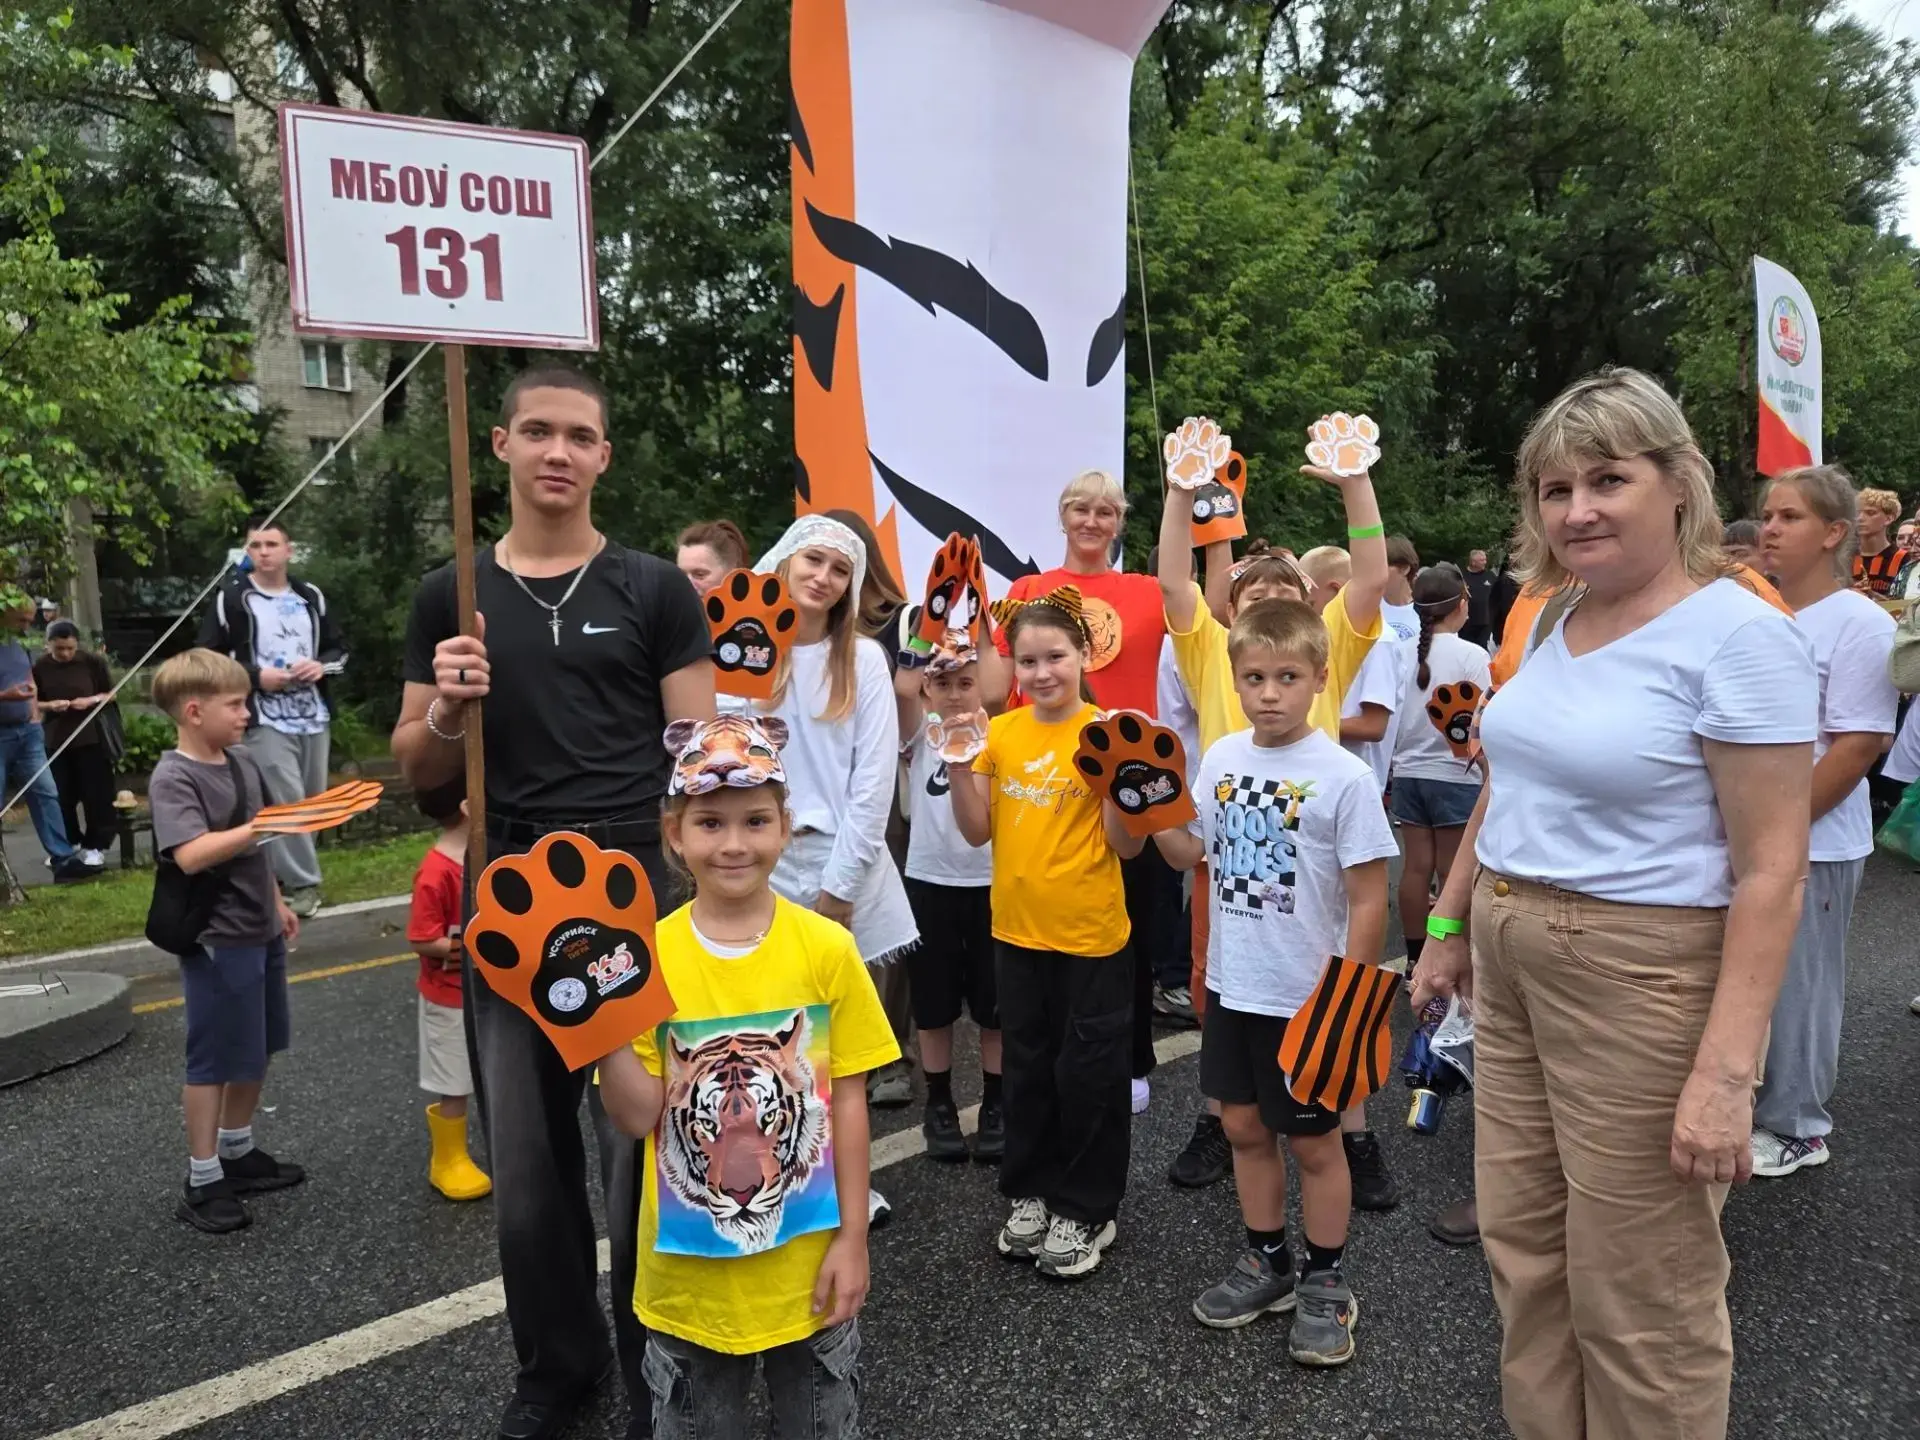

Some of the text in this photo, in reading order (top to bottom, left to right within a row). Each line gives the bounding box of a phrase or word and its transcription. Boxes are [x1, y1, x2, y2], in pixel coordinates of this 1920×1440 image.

[329, 157, 553, 220] МБОУ СОШ
[385, 225, 504, 302] 131
[1225, 906, 1264, 921] EVERYDAY
[548, 925, 599, 959] УССУРИЙСК
